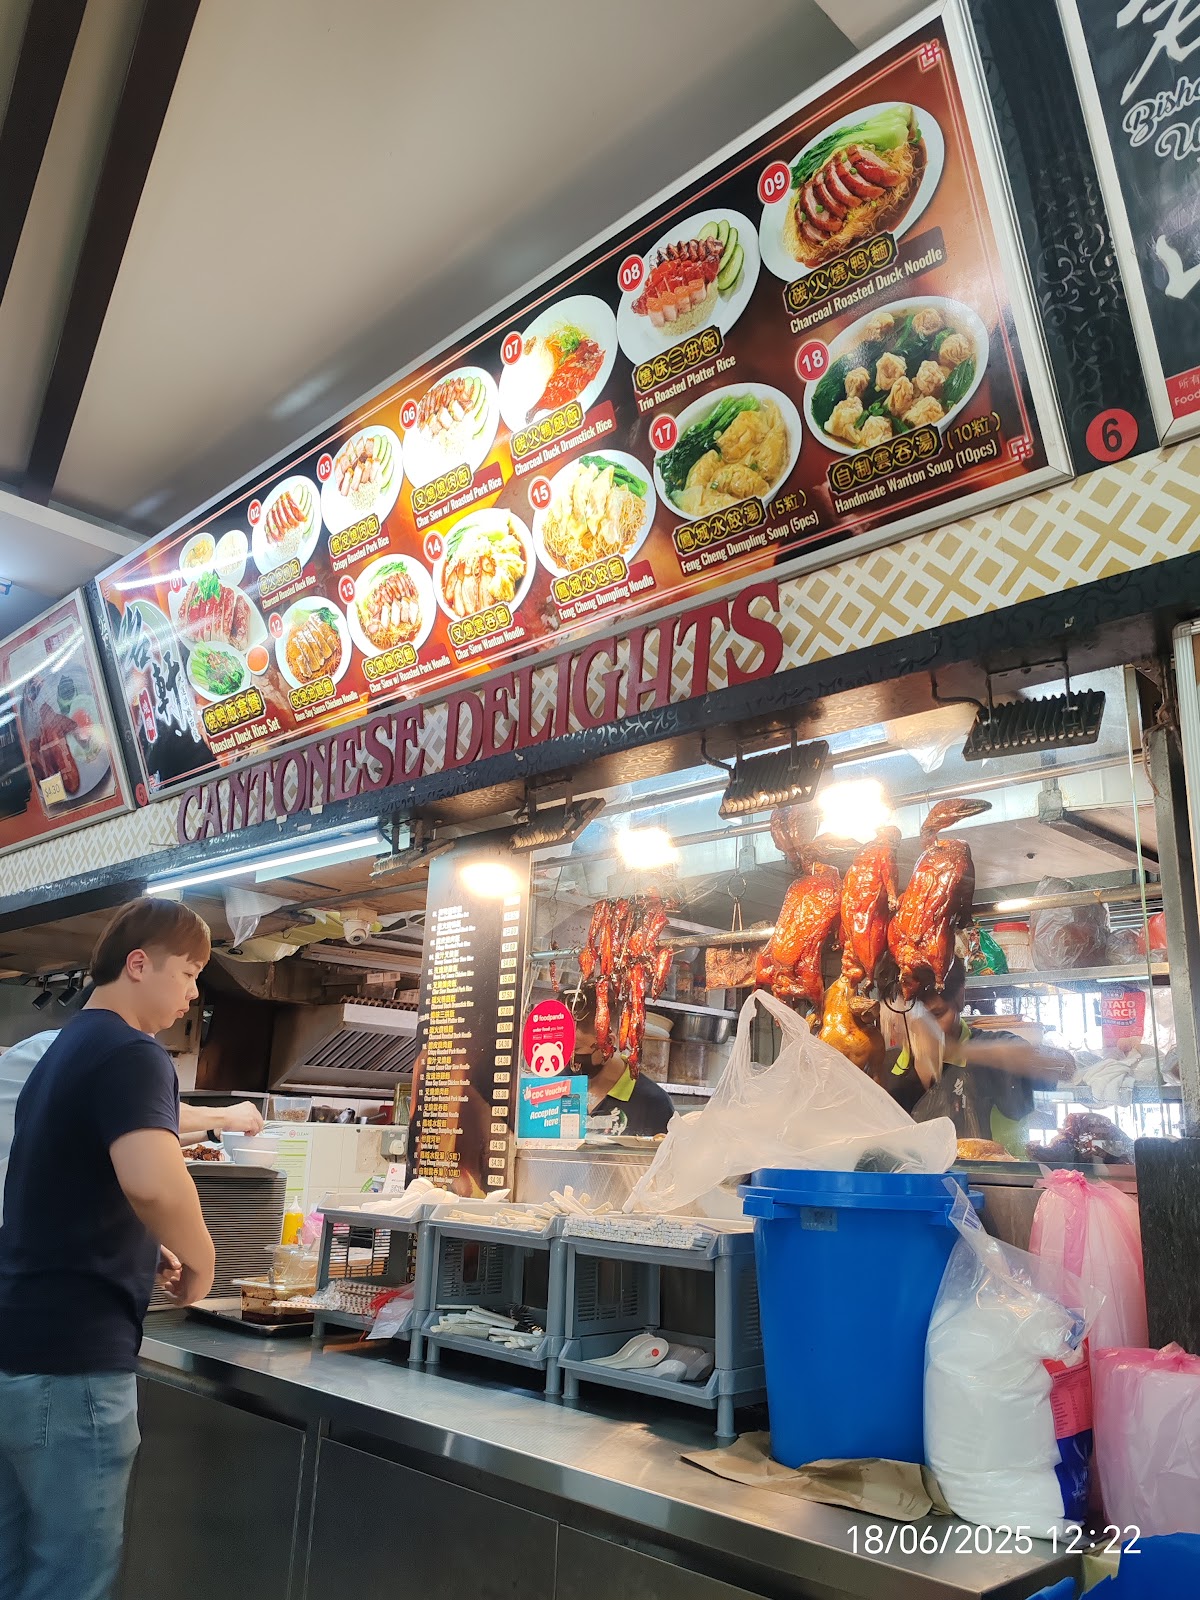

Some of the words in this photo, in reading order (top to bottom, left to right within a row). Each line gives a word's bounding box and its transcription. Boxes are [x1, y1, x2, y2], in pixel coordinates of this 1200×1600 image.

[764, 172, 785, 196] 09
[623, 264, 640, 285] 08
[790, 304, 832, 334] Charcoal
[835, 281, 874, 311] Roasted
[876, 268, 902, 290] Duck
[904, 248, 942, 276] Noodle
[505, 339, 519, 359] 07
[802, 350, 824, 373] 18
[638, 395, 654, 412] Trio
[655, 378, 686, 405] Roasted
[687, 364, 715, 388] Platter
[716, 356, 736, 372] Rice
[403, 407, 414, 423] 06
[655, 423, 672, 443] 17
[1102, 418, 1122, 452] 6
[515, 454, 545, 476] Charcoal
[544, 446, 560, 461] Duck
[561, 427, 595, 452] Drumstick
[596, 418, 612, 433] Rice
[320, 461, 330, 476] 03
[835, 485, 886, 513] Handmade
[887, 470, 925, 496] Wanton
[929, 459, 954, 478] Soup
[956, 440, 997, 468] (10pcs)
[416, 515, 429, 528] Char
[429, 509, 442, 521] Siew
[451, 493, 473, 511] Roasted
[473, 485, 487, 498] Pork
[488, 478, 502, 491] Rice
[533, 485, 548, 503] 15
[251, 507, 259, 520] 02
[428, 539, 440, 555] 14
[681, 557, 701, 573] Feng
[701, 546, 727, 566] Cheng
[727, 531, 767, 555] Dumpling
[767, 524, 789, 541] Soup
[790, 510, 819, 534] (5pcs)
[333, 556, 348, 571] Crispy
[348, 546, 365, 562] Roasted
[366, 540, 378, 554] Pork
[378, 536, 389, 548] Rice
[343, 583, 353, 597] 13
[559, 607, 576, 620] Feng
[575, 598, 597, 612] Cheng
[598, 586, 630, 604] Dumpling
[629, 575, 654, 593] Noodle
[272, 620, 281, 632] 12
[456, 647, 469, 660] Char
[469, 642, 482, 654] Siew
[482, 632, 504, 650] Wanton
[504, 626, 524, 640] Noodle
[369, 682, 381, 693] Char
[431, 655, 450, 669] Noodle
[177, 703, 426, 846] CANTONESE
[444, 582, 785, 769] DELIGHTS
[210, 734, 236, 754] Roasted
[235, 728, 253, 744] Duck
[251, 724, 268, 738] Rice
[266, 717, 281, 732] Set
[1102, 1000, 1136, 1009] OTATO
[1102, 1009, 1137, 1017] TARCH
[539, 1013, 564, 1023] foodpanda
[532, 1090, 544, 1100] CDC
[530, 1106, 559, 1120] Accepted
[544, 1118, 559, 1128] here
